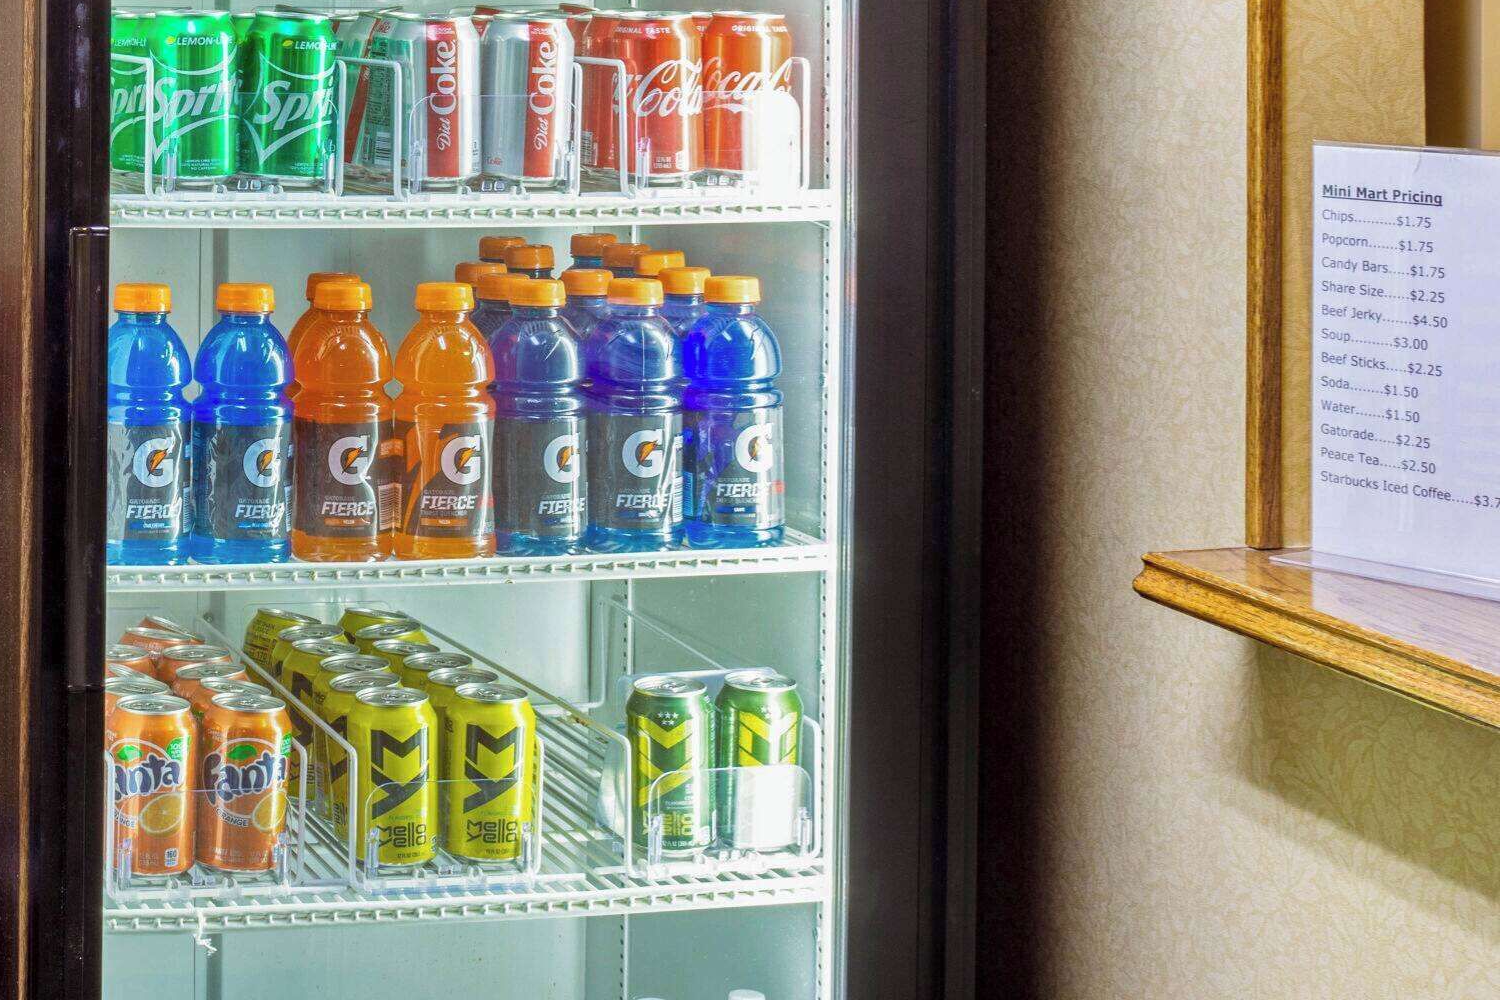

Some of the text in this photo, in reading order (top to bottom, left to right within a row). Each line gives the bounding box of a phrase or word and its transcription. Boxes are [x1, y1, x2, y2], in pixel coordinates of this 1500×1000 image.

[645, 26, 672, 35] TASTE
[430, 40, 457, 115] Coke
[529, 40, 557, 115] Coke
[437, 117, 450, 151] Diet
[533, 117, 548, 151] Diet
[1322, 184, 1443, 206] Mini Mart Pricing
[1322, 256, 1358, 272] Candy
[1322, 280, 1356, 295] Share
[1321, 304, 1347, 318] Beef
[1321, 352, 1347, 365] Beef
[132, 438, 174, 488] G
[243, 438, 281, 488] G
[328, 435, 369, 485] G
[441, 435, 481, 485] G
[544, 433, 580, 483] G
[622, 429, 663, 478] G
[735, 423, 774, 472] G
[1321, 447, 1355, 462] Peace
[1321, 470, 1379, 490] Starbucks
[1383, 480, 1409, 495] Iced
[321, 501, 375, 516] FIERCE
[420, 495, 477, 510] FIERCE
[114, 752, 184, 802] anta
[203, 750, 288, 807] Fanta
[467, 819, 518, 833] Mello
[467, 831, 518, 844] Yello
